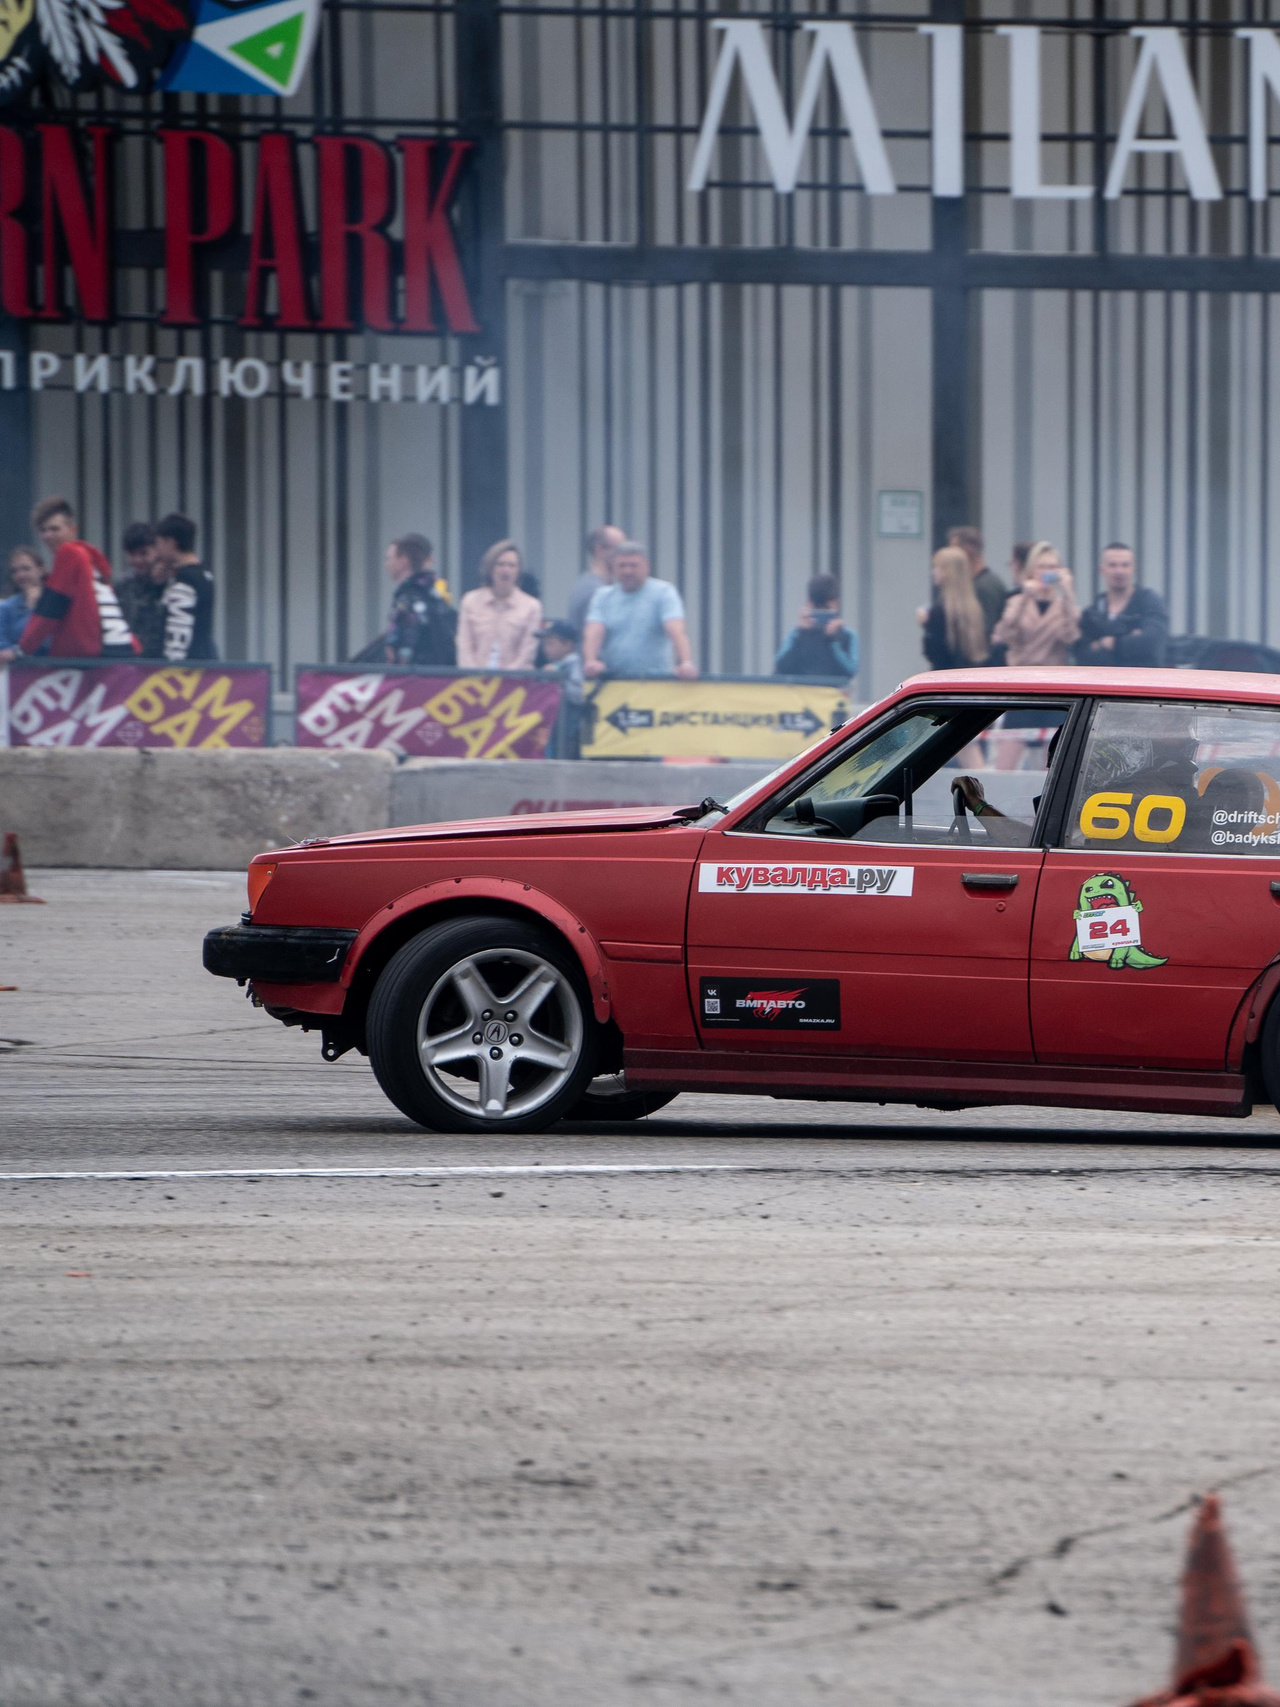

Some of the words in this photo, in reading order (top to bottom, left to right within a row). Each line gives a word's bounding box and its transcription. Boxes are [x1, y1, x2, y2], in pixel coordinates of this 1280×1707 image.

[158, 129, 482, 333] PARK
[1080, 792, 1187, 843] 60
[717, 866, 897, 893] кувалда.ру
[1089, 918, 1130, 939] 24
[735, 999, 806, 1009] ВМПАВТО
